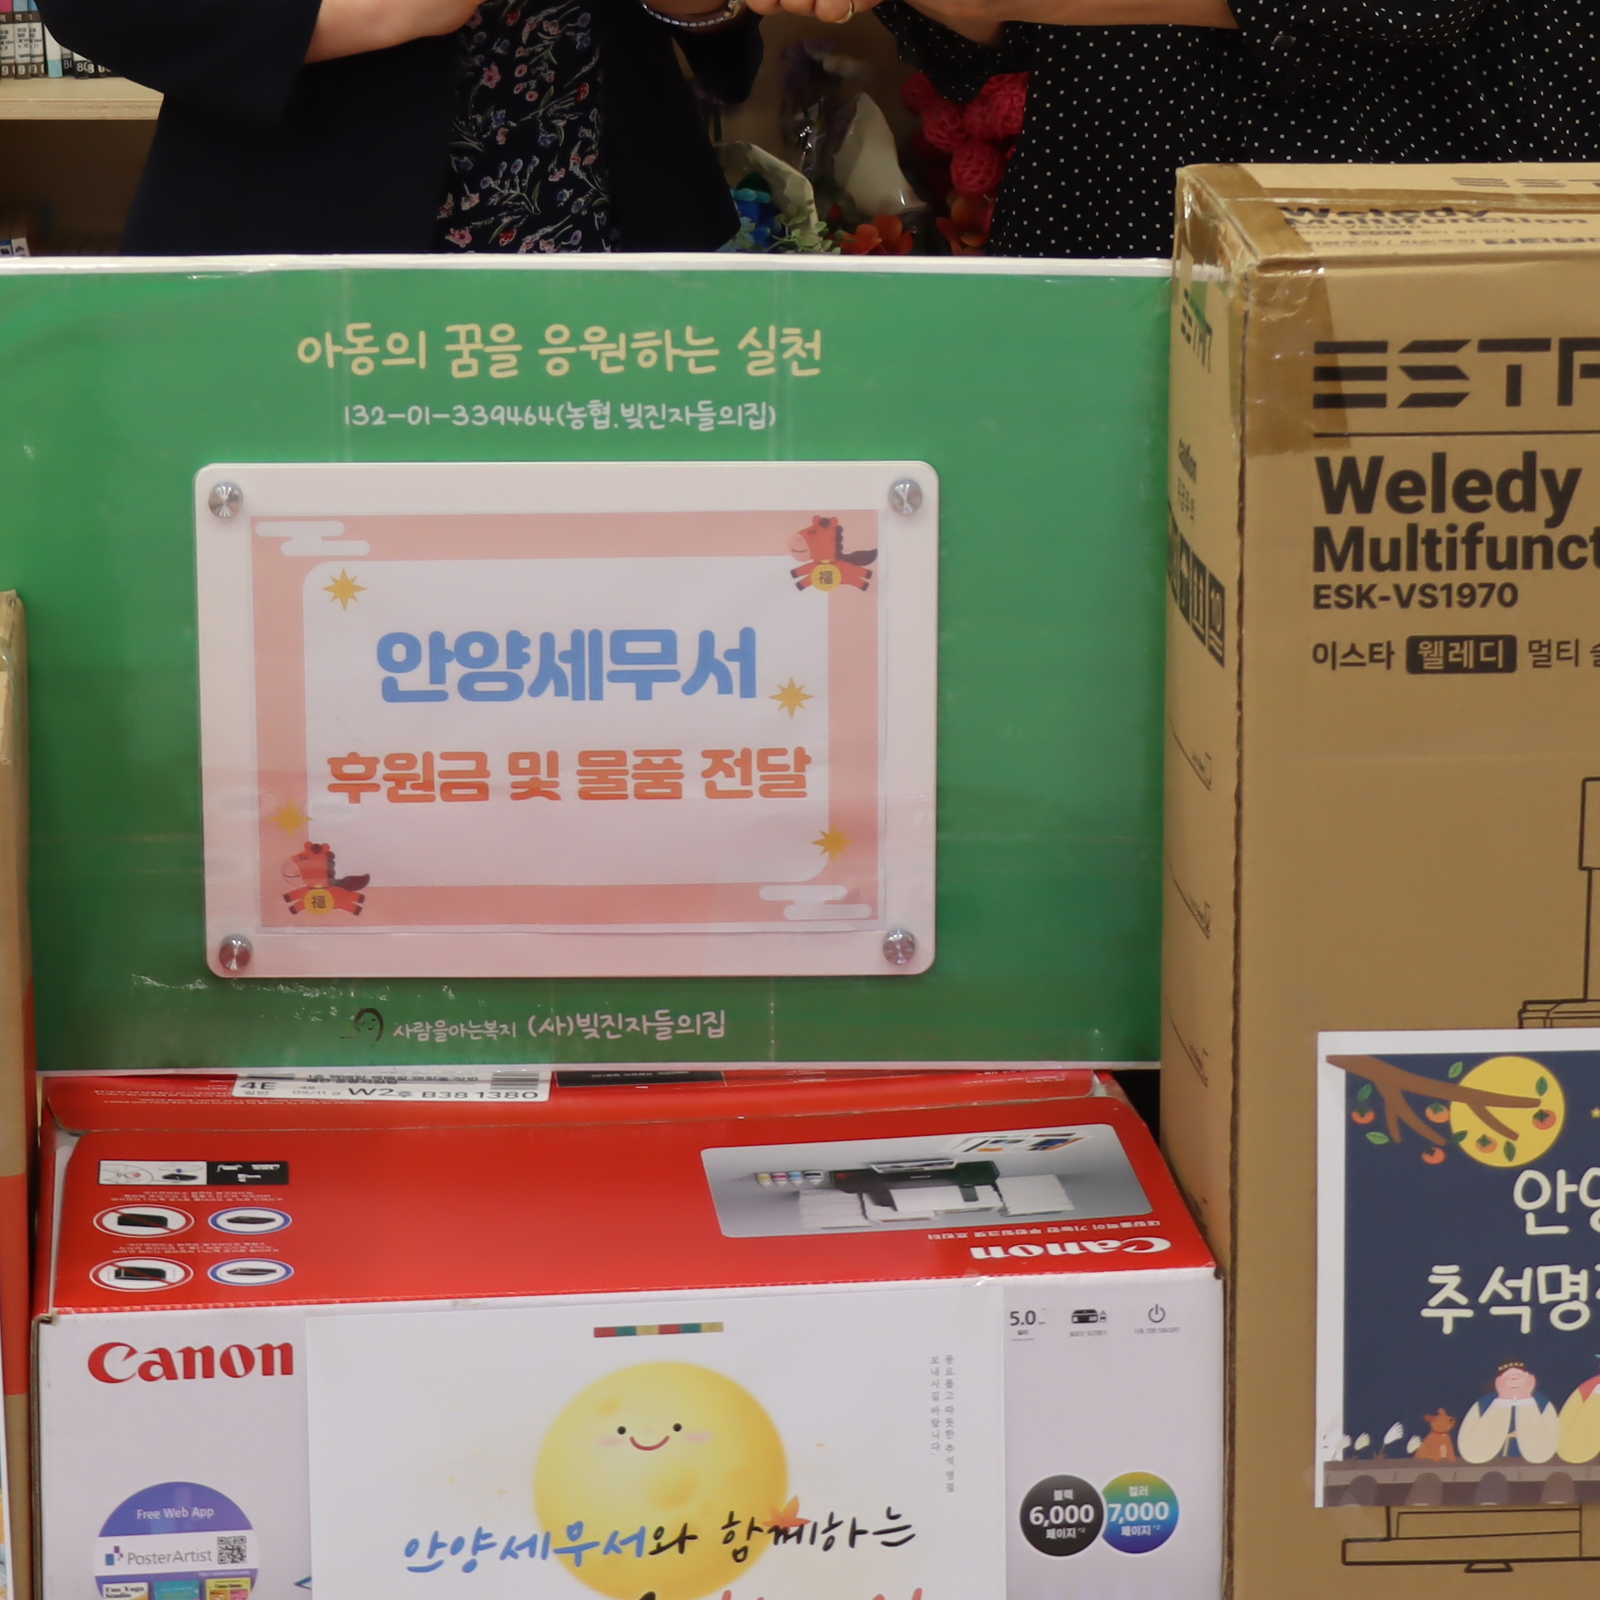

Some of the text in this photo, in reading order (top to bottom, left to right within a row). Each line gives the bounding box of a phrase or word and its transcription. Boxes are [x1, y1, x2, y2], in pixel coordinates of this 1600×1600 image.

[296, 321, 823, 379] 아동의 꿈을 응원하는 실천
[1314, 451, 1583, 527] Weledy
[1312, 581, 1520, 611] ESK-VS1970
[376, 625, 760, 704] 안양세무서
[1311, 640, 1396, 671] 이스타
[1527, 638, 1581, 668] 멀티
[326, 745, 813, 804] 후원금 및 물품 전달
[475, 1090, 539, 1099] 1380
[970, 1236, 1172, 1260] Canon
[1009, 1310, 1036, 1326] 5.0
[87, 1341, 294, 1384] Canon
[136, 1505, 215, 1520] Free Web App
[1029, 1503, 1095, 1527] 6,000
[1107, 1501, 1170, 1524] 7,000
[720, 1505, 917, 1563] 함께하는
[127, 1548, 213, 1566] PosterArtist
